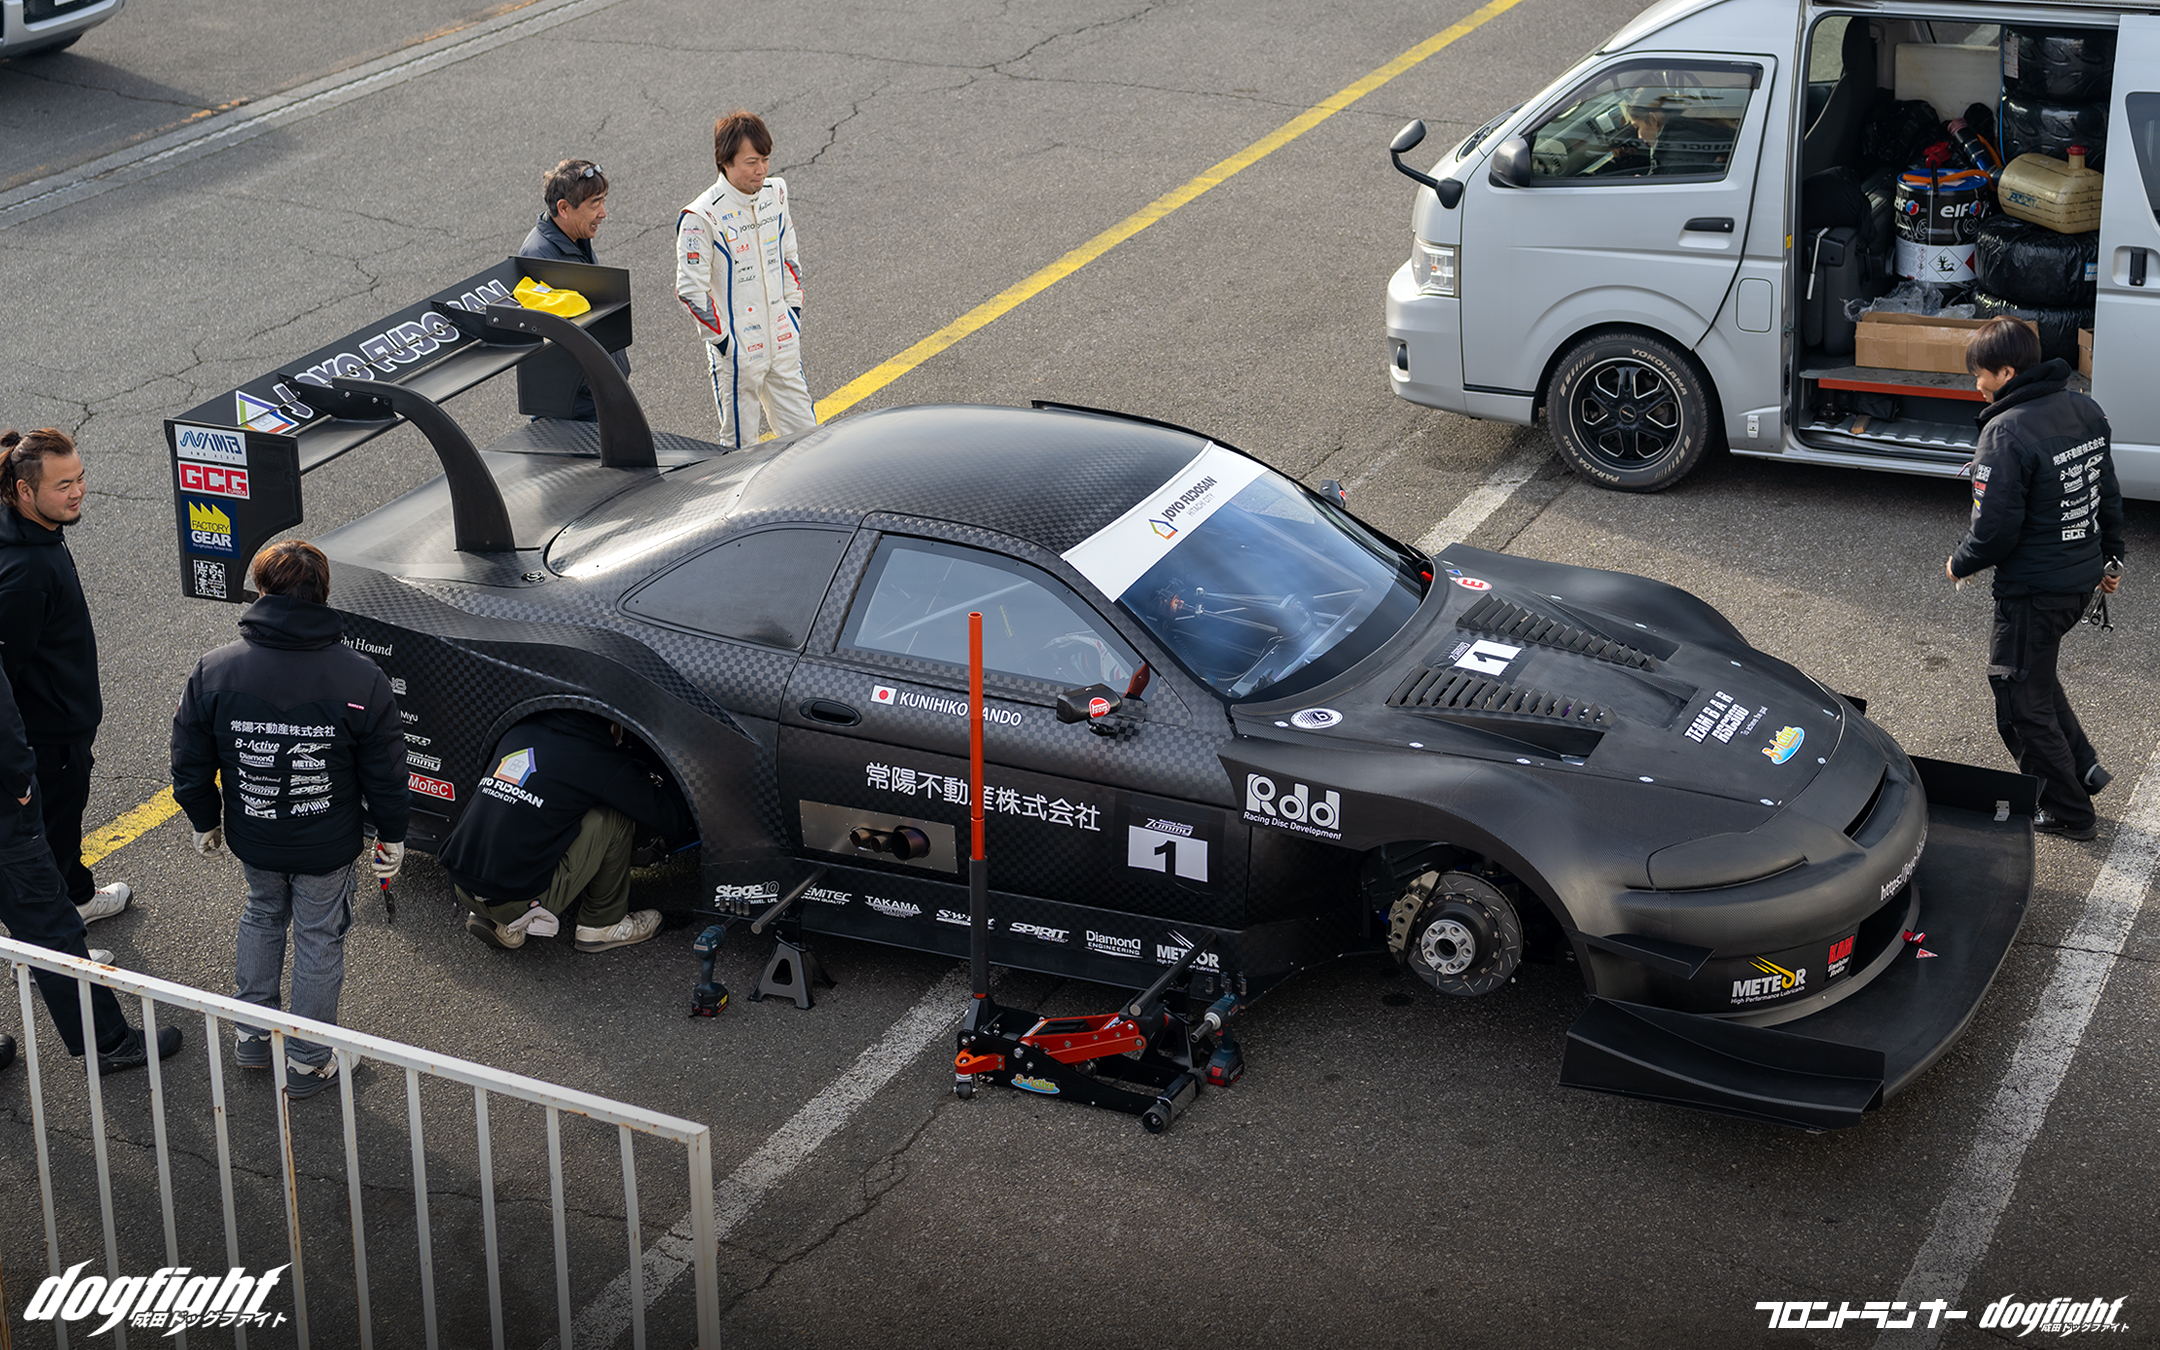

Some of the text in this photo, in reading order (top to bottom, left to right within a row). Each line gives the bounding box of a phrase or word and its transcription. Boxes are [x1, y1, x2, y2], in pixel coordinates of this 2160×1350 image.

[1940, 203, 1969, 218] elf
[1631, 348, 1688, 396] YOKOHAMA
[180, 463, 248, 496] GCG
[1578, 456, 1620, 482] PARADA
[1161, 475, 1217, 522] JOYO FUDOSAN
[192, 520, 230, 532] FACTORY
[2062, 529, 2087, 541] GCG
[191, 530, 233, 548] GEAR
[355, 637, 393, 657] Hound
[1473, 651, 1515, 663] 1
[900, 691, 1023, 727] KUNIHIKO ANDO
[230, 720, 336, 738] 常陽不動産株式会社
[1684, 713, 1716, 743] TEAM
[1711, 704, 1750, 744] RACING
[235, 738, 280, 751] B-Active
[292, 759, 326, 768] METEOR
[408, 774, 449, 797] MoTeC
[494, 780, 544, 808] FUDOSAN
[866, 762, 1101, 832] 常陽不動産株式会社
[1246, 773, 1341, 830] Rdd
[245, 804, 277, 820] GCG
[1243, 811, 1342, 841] Racing Disc Development
[1154, 839, 1177, 874] 1
[864, 895, 920, 913] TAKAMA
[1009, 922, 1070, 940] SPIRIT
[1087, 941, 1140, 956] ENGINEERING
[1156, 944, 1220, 968] METOR
[1731, 966, 1807, 998] METEOR
[1731, 985, 1806, 1005] High Performance Lubricants
[1015, 1074, 1056, 1091] B-Active
